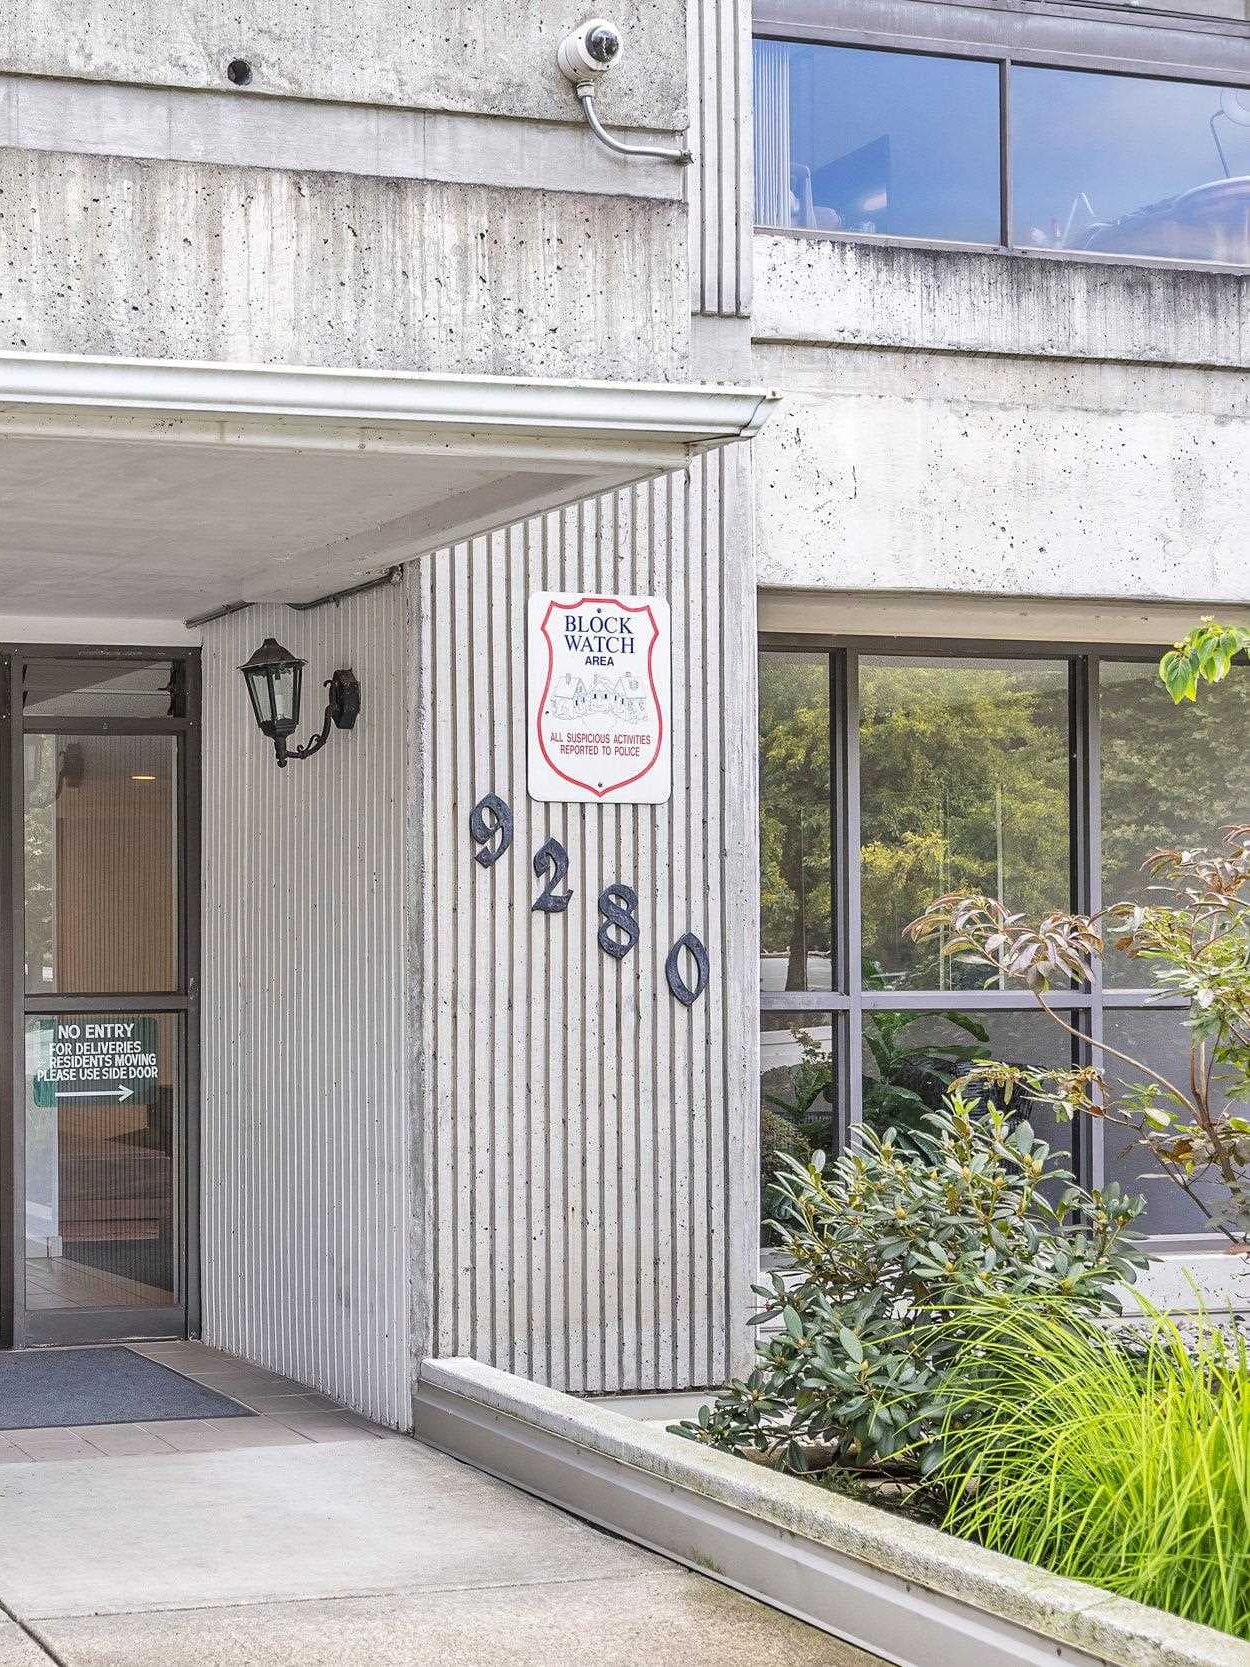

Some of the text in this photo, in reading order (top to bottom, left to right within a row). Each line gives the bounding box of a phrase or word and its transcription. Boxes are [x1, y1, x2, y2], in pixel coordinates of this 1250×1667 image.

[565, 615, 634, 635] BLOCK
[564, 635, 635, 654] WATCH
[584, 655, 615, 667] AREA
[550, 731, 651, 745] ALL SUSPICIOUS ACTIVITIES
[560, 744, 640, 757] REPORTED TO POLICE
[469, 792, 710, 1007] 9280
[58, 1022, 135, 1040] NO ENTRY
[48, 1041, 142, 1056] FOR DELIVERIES
[49, 1054, 113, 1069] RESIDENTS
[114, 1053, 157, 1067] MOVING
[37, 1066, 159, 1082] PLEASE USE SIDE DOOR
